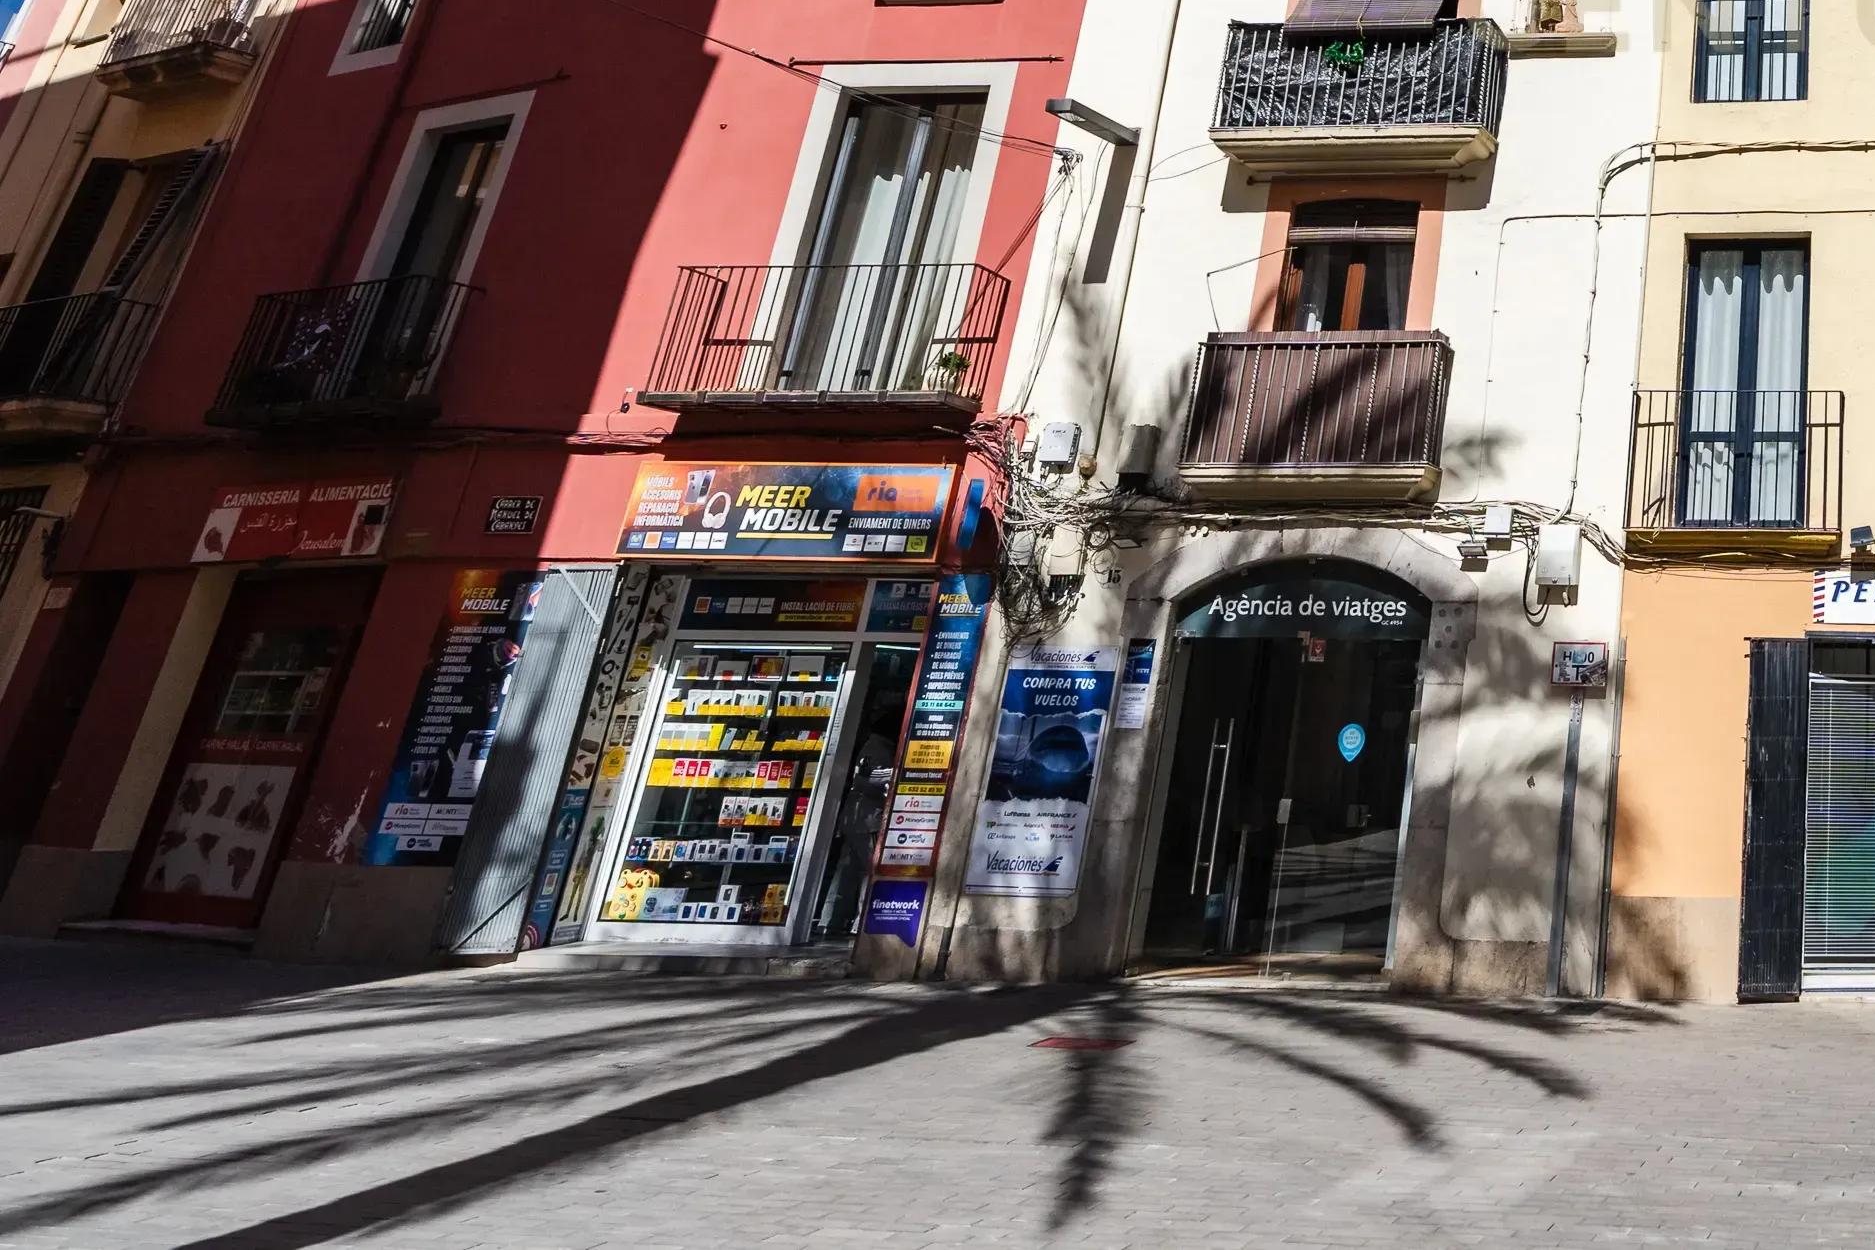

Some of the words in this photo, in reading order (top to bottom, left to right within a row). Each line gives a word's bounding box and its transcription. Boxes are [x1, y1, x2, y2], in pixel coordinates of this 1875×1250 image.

[223, 489, 299, 508] CARNISSERIA
[309, 480, 392, 501] ALIMENTACIÓ
[642, 489, 683, 501] ACCESORIS
[735, 485, 812, 508] MEER
[867, 480, 898, 501] ria
[637, 501, 679, 513] REPARACIÓ
[739, 508, 842, 531] MOBILE
[848, 517, 892, 529] ENVIAMENT
[892, 518, 902, 528] DE
[903, 518, 932, 530] DINERS
[288, 530, 345, 554] Jerusalem
[461, 587, 497, 598] MEER
[938, 593, 970, 603] MEER
[461, 599, 510, 610] MOBILE
[940, 603, 982, 614] MOBILE
[1208, 594, 1293, 622] Agència
[1299, 594, 1325, 616] de
[1332, 595, 1407, 623] viatges
[1030, 647, 1082, 663] Vacaciones
[1023, 677, 1071, 689] COMPRA
[1075, 678, 1097, 690] TUS
[1034, 694, 1079, 706] VUELOS
[904, 797, 920, 807] ria
[986, 850, 1043, 872] Vacaciones
[873, 899, 920, 909] finetwork
